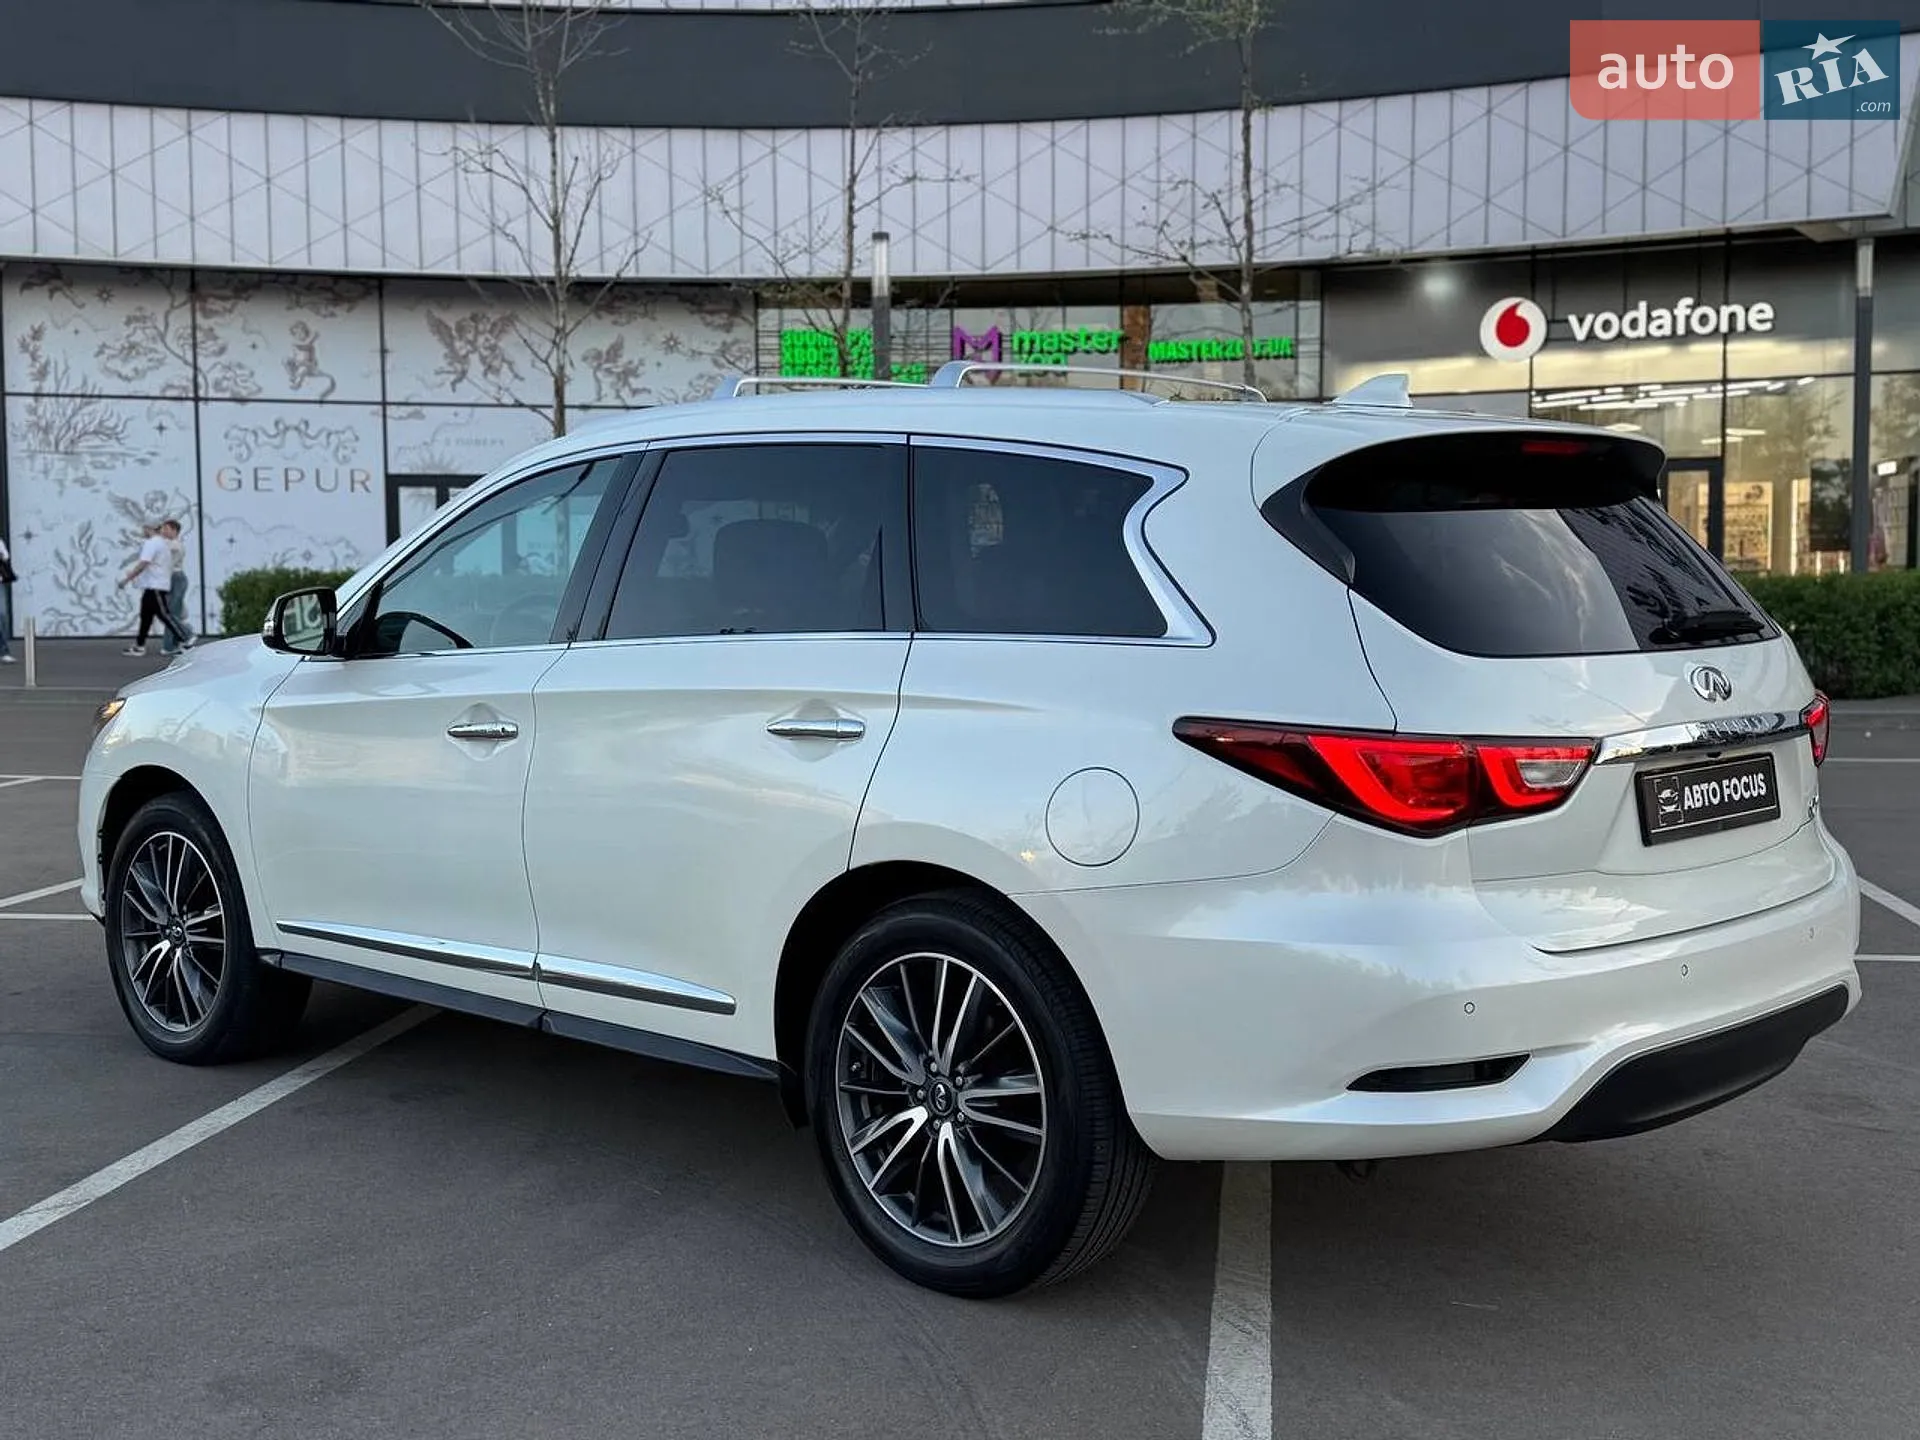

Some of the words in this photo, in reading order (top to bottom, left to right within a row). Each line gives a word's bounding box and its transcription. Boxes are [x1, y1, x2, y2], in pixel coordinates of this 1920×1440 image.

[1567, 297, 1775, 342] vodafone
[1012, 323, 1124, 353] master
[216, 465, 372, 494] GEPUR
[1722, 772, 1767, 802] FOCUS
